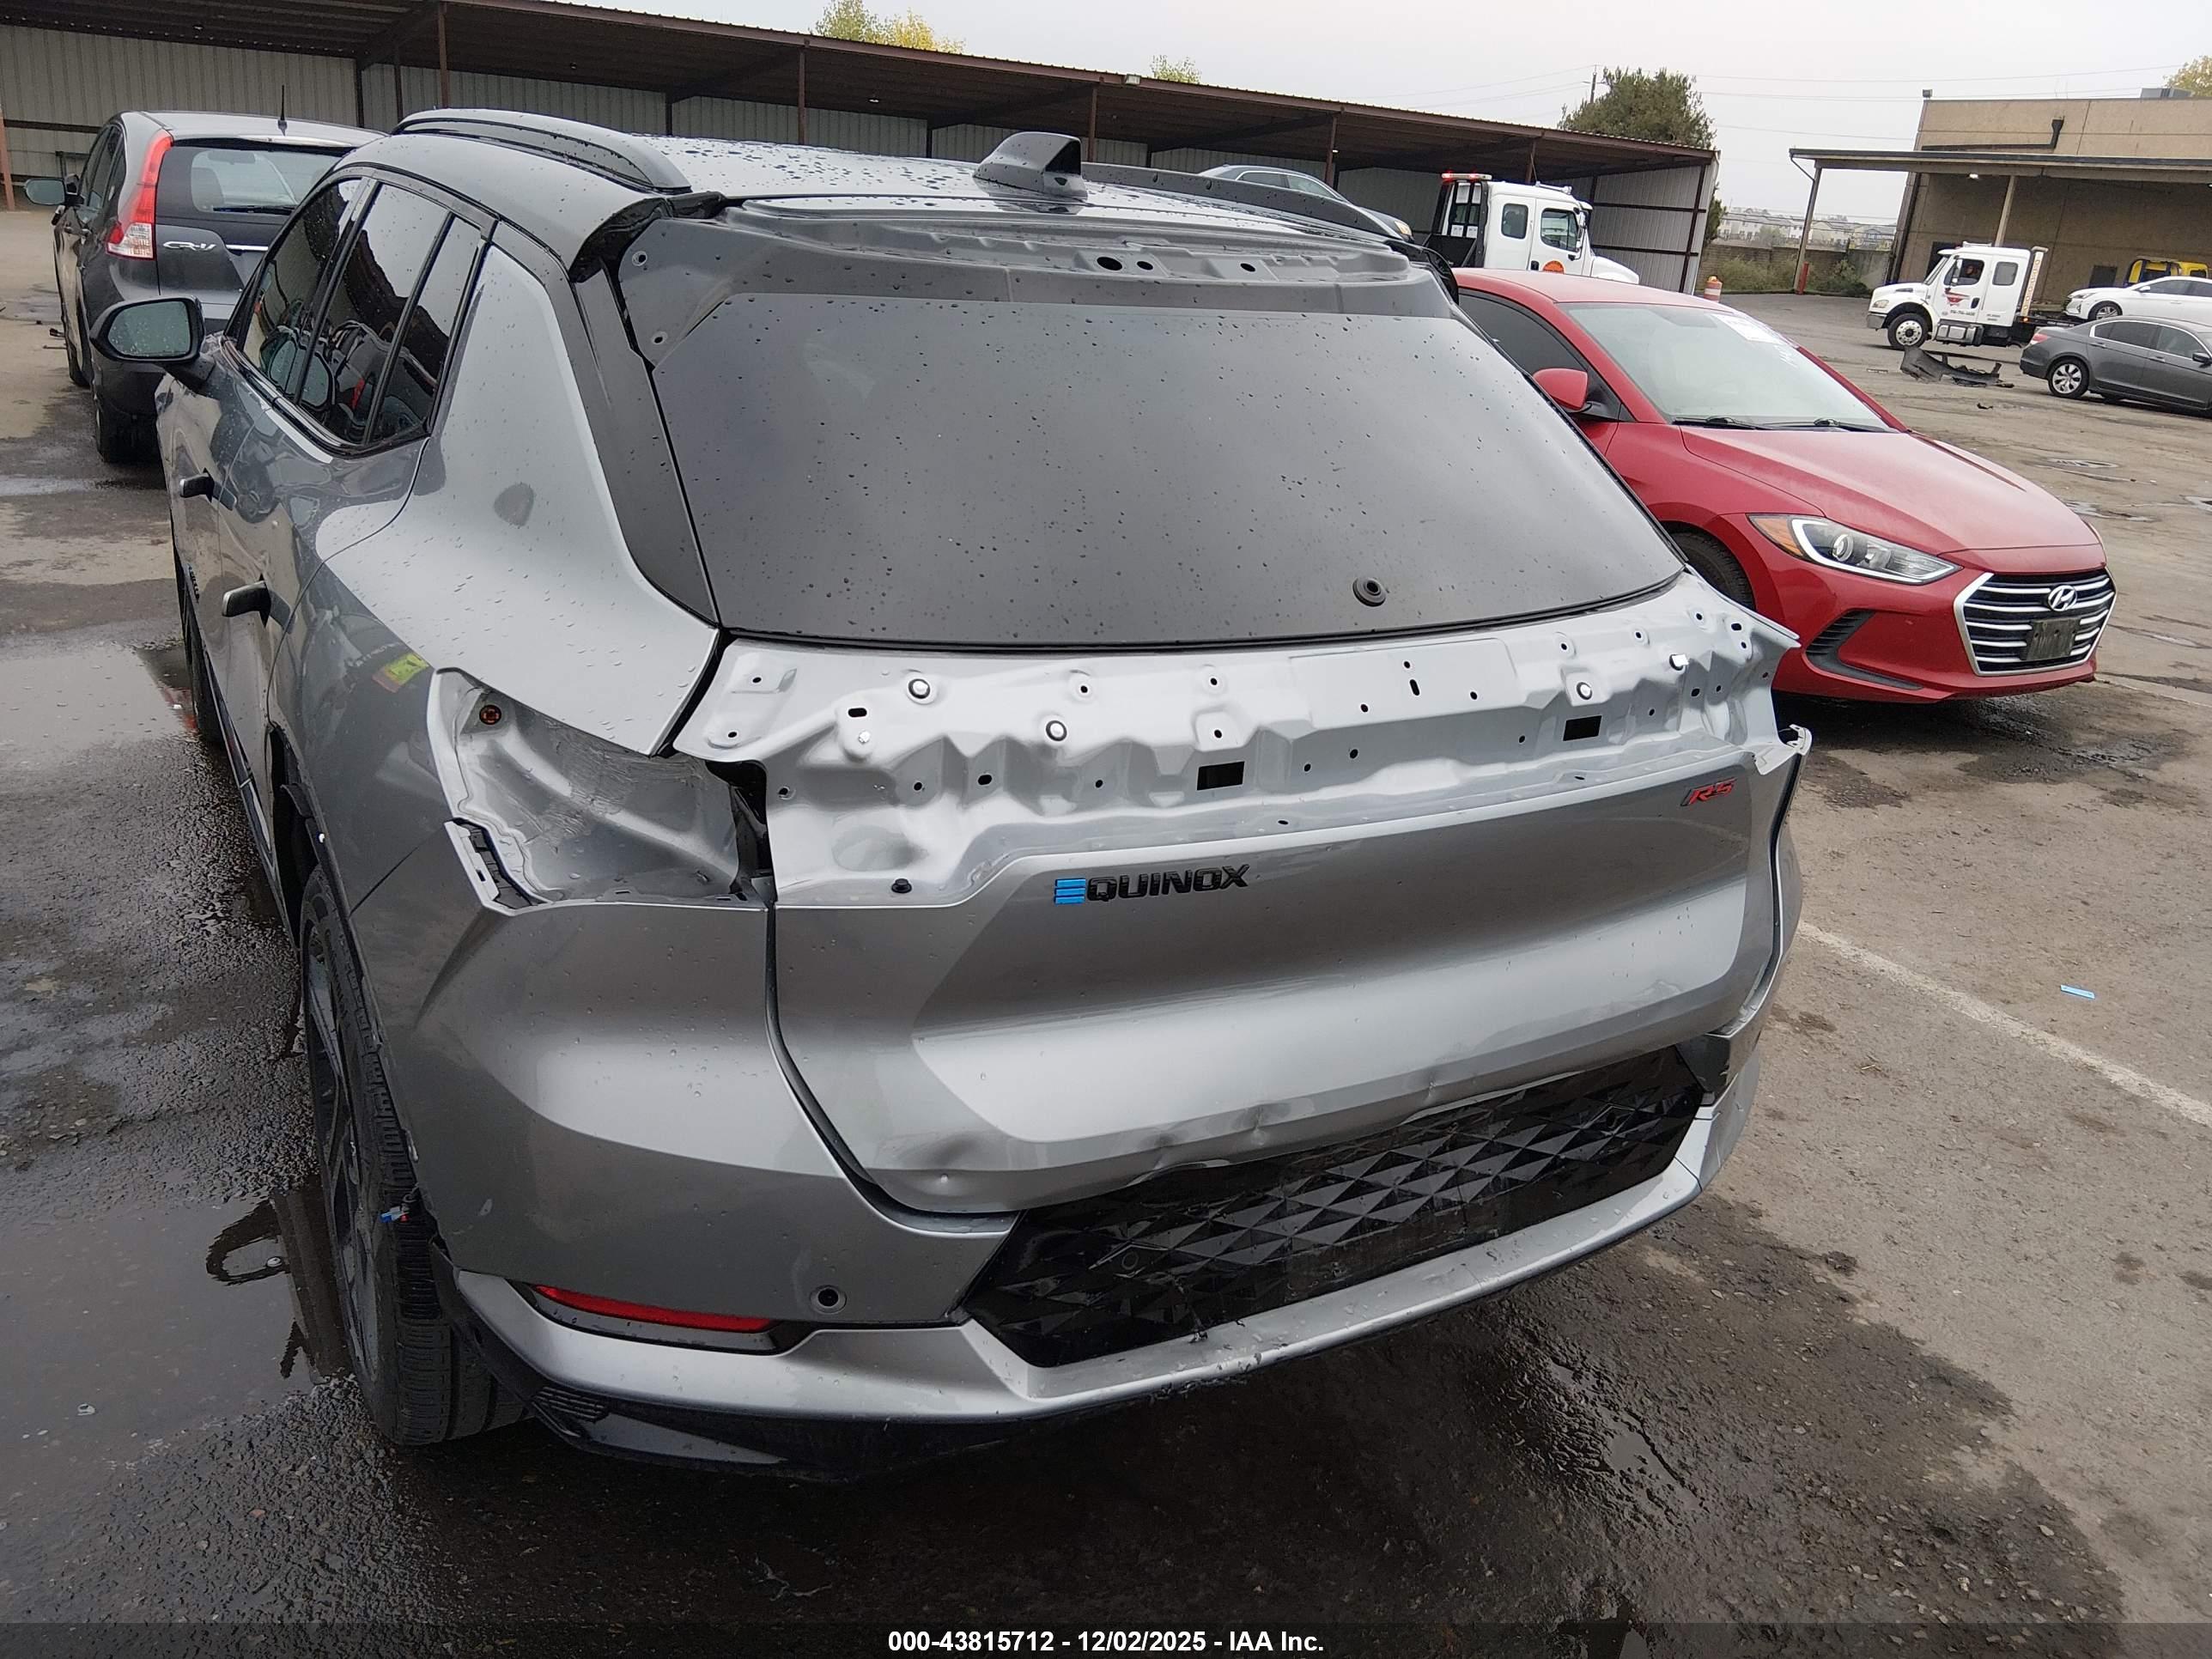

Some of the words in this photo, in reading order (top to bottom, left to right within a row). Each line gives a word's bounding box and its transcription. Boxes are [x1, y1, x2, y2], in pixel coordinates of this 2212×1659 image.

[161, 240, 217, 252] CR-V
[1683, 776, 1737, 805] RS
[1054, 864, 1250, 905] EQUINOX
